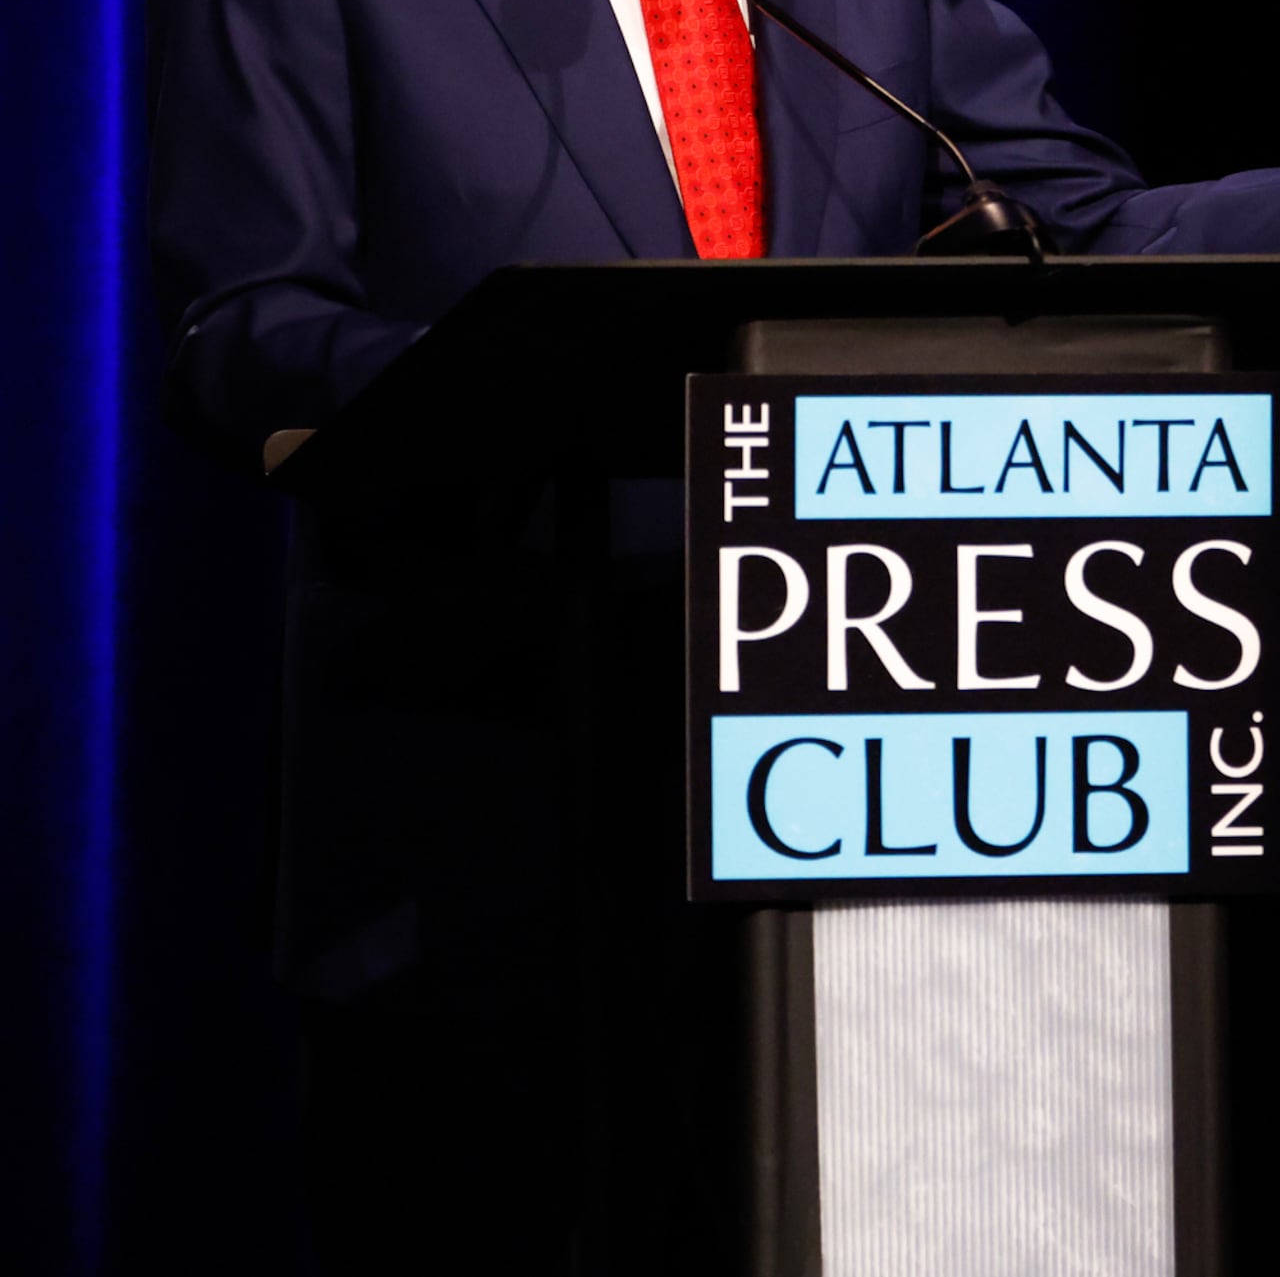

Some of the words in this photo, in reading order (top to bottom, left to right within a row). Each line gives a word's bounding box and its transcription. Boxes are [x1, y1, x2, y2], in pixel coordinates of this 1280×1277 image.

[725, 403, 769, 521] THE
[817, 418, 1248, 494] ATLANTA
[720, 540, 1260, 691] PRESS
[747, 735, 1149, 860] CLUB
[1211, 712, 1263, 855] INC.
